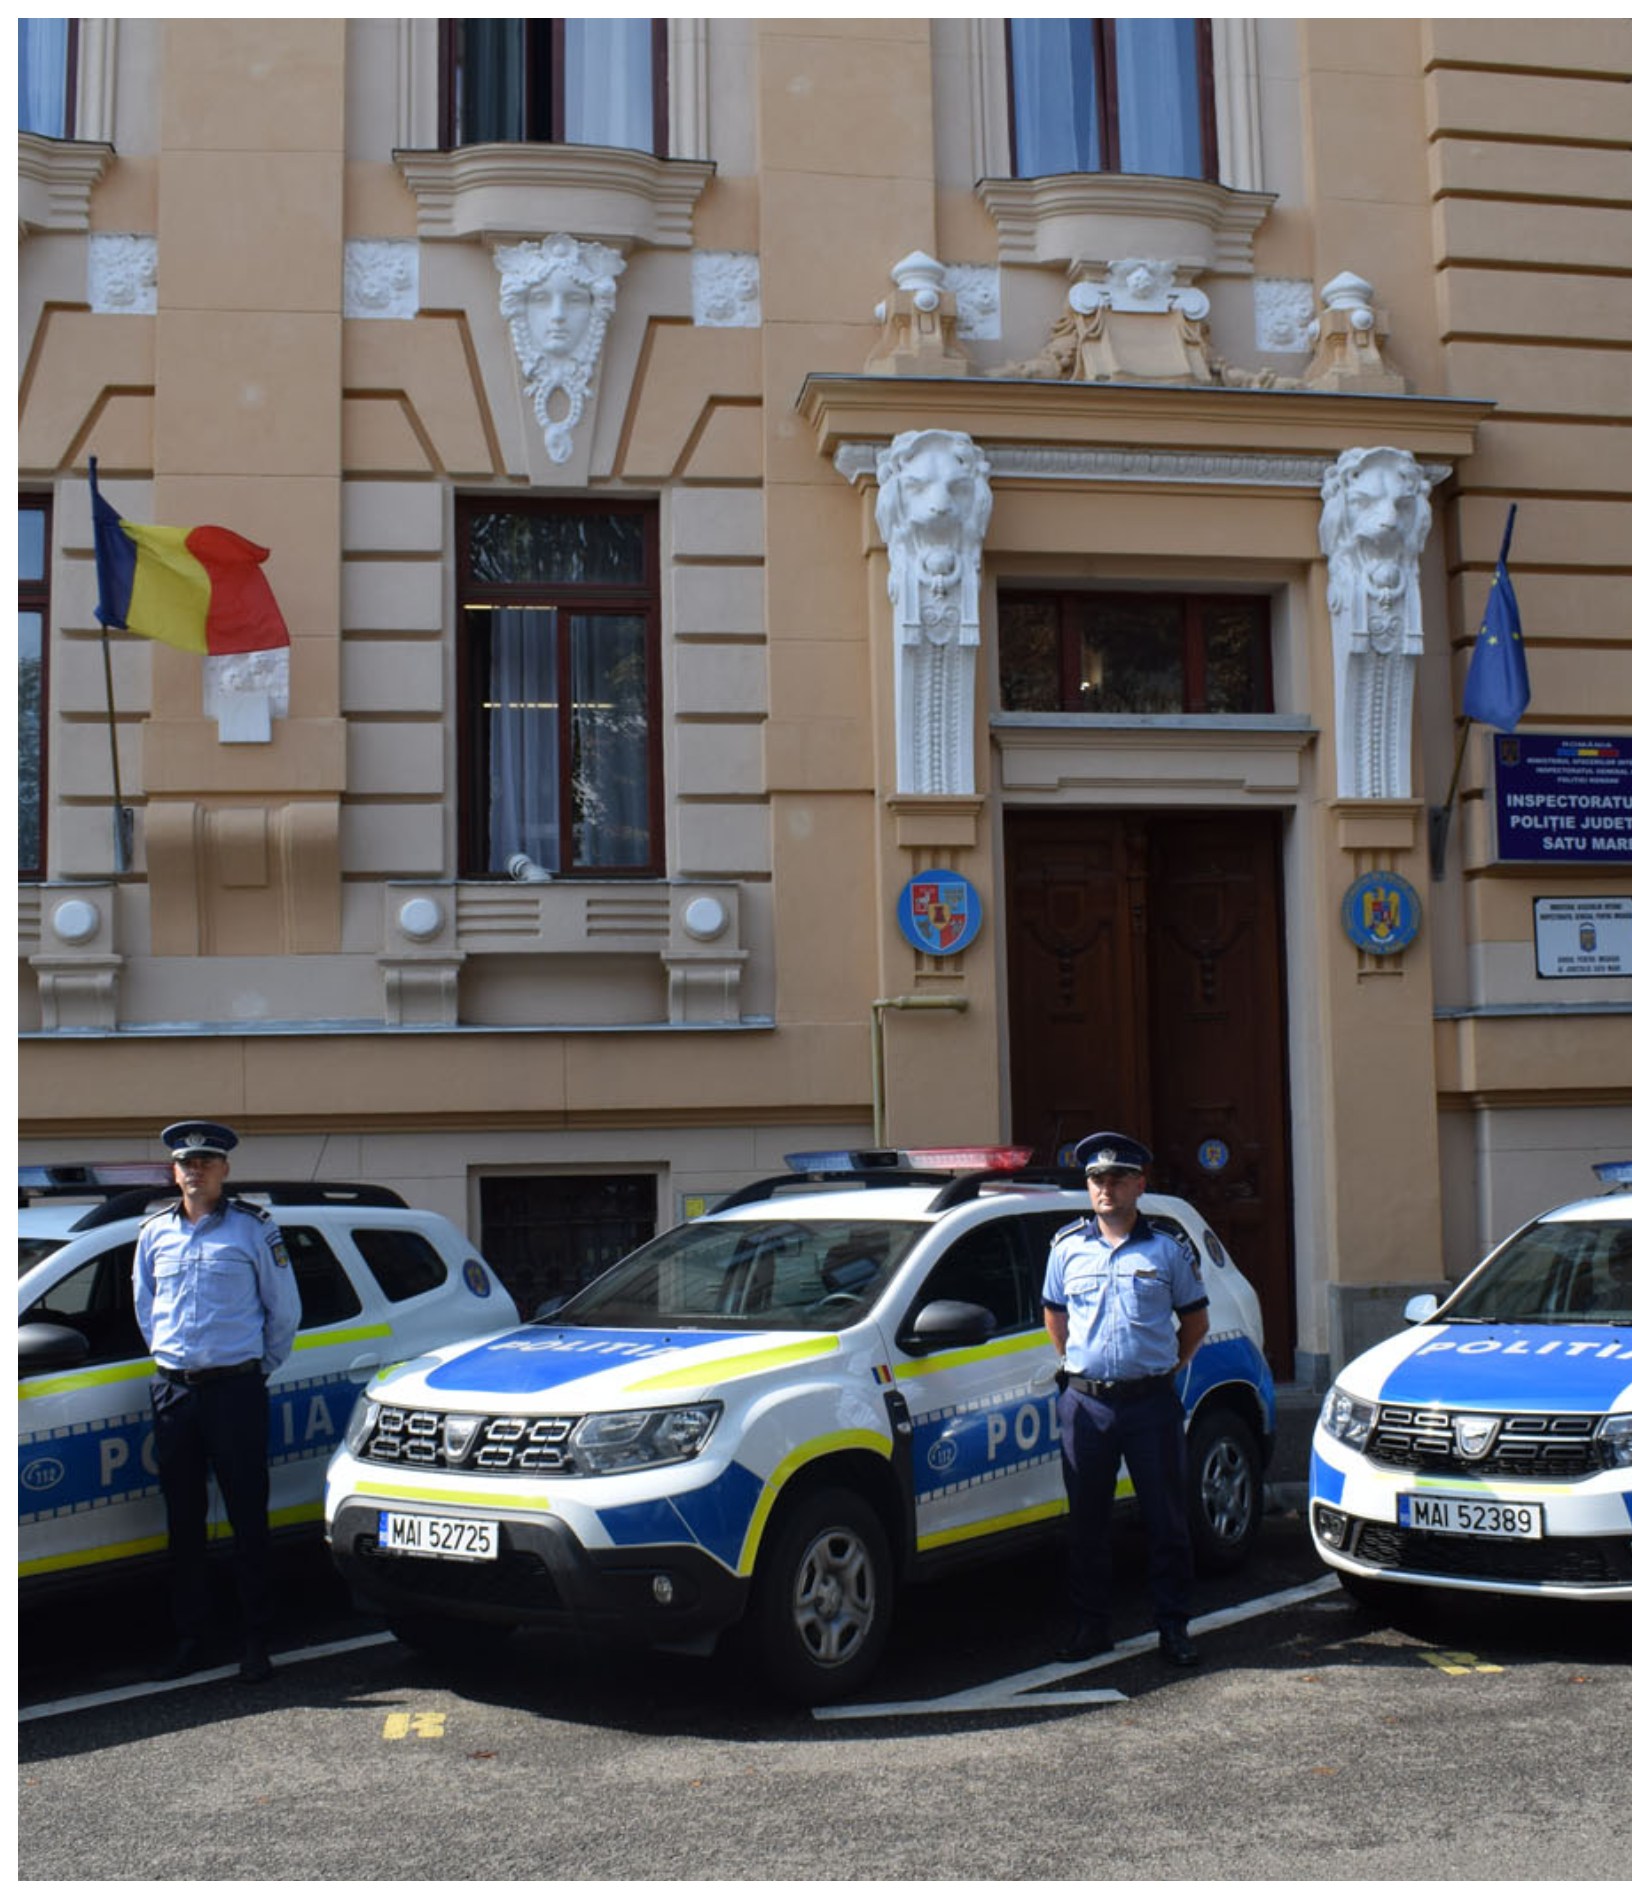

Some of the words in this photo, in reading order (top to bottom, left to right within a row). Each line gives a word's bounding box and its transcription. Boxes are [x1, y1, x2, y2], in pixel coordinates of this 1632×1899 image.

[1543, 837, 1586, 850] SATU
[1415, 1501, 1449, 1527] MAI
[1457, 1504, 1532, 1533] 52389
[392, 1518, 421, 1546] MAI
[429, 1521, 491, 1552] 52725
